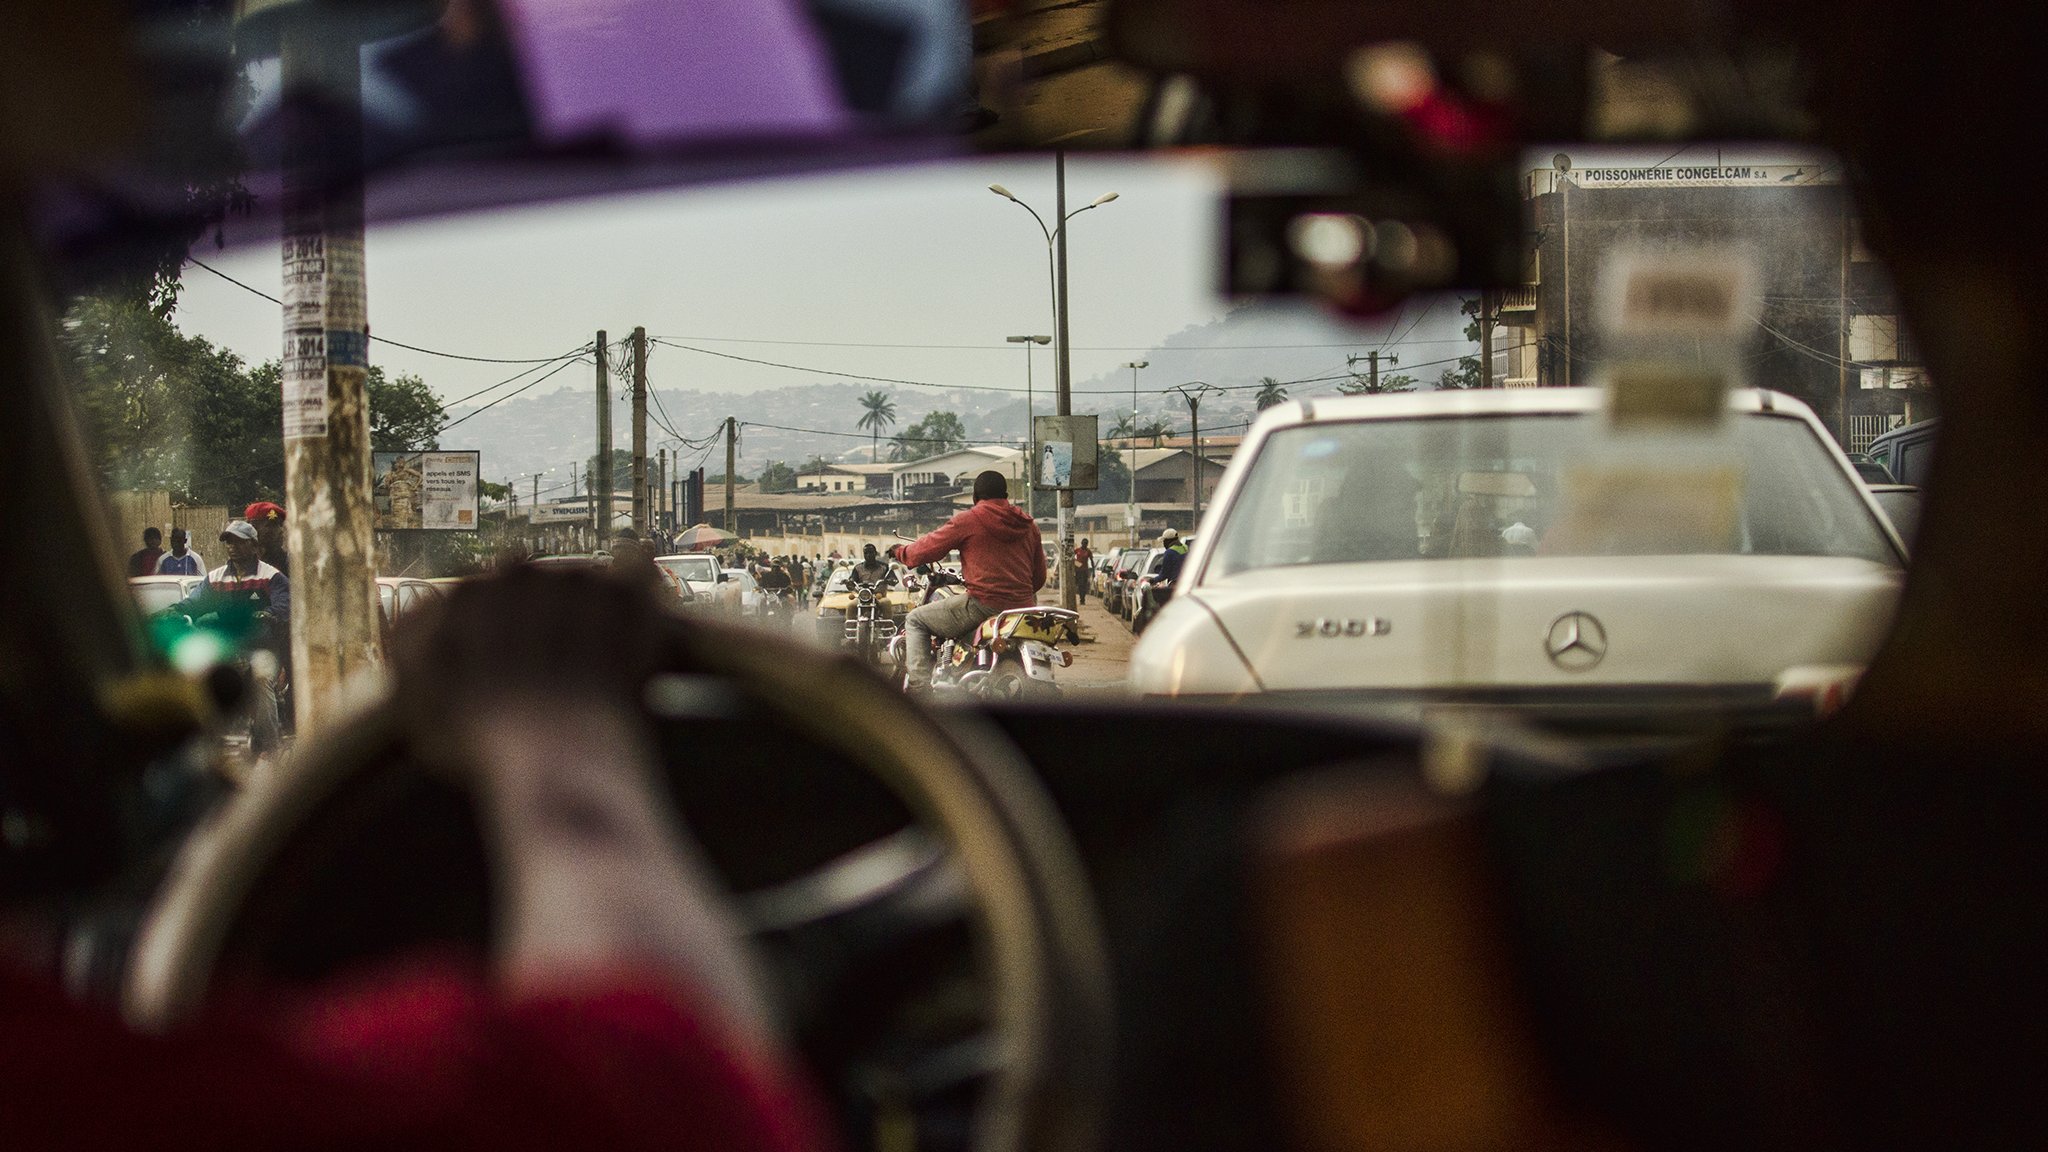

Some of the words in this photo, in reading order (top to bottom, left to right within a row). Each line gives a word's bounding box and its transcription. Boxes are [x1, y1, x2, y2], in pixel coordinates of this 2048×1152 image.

[1585, 168, 1673, 181] POISSONNERIE
[1676, 167, 1750, 180] CONGELCAM
[298, 337, 324, 355] 2014
